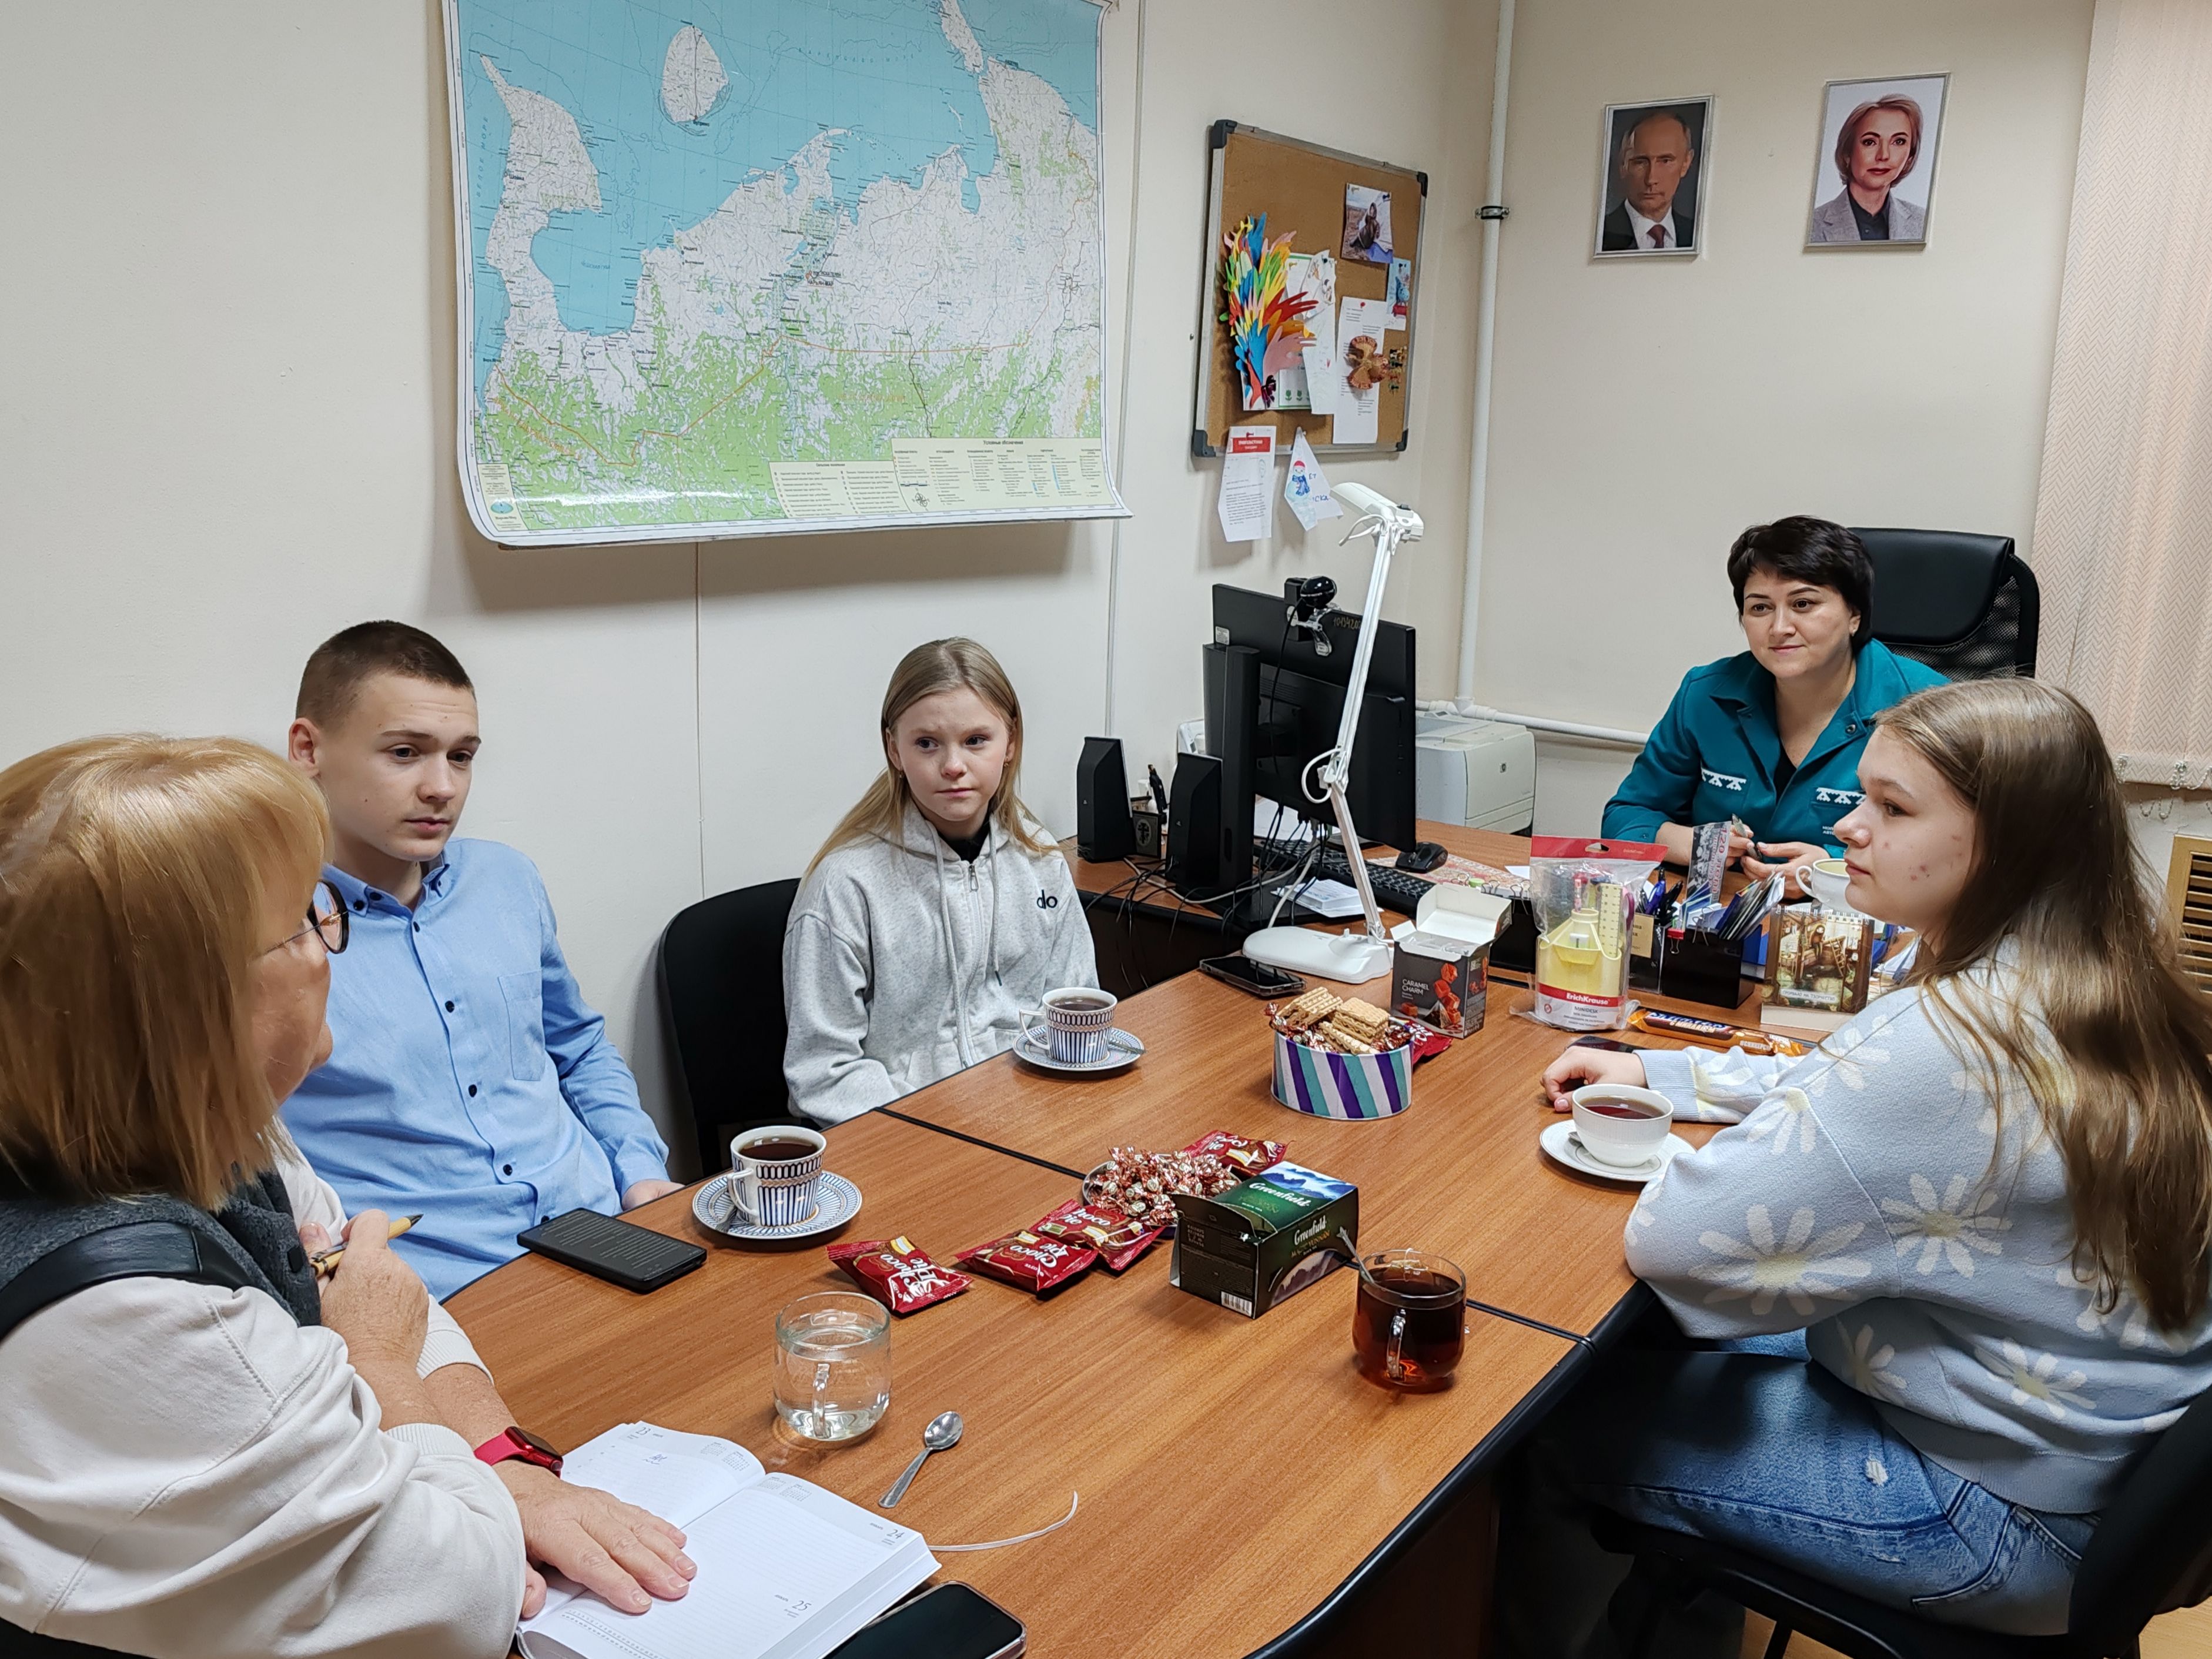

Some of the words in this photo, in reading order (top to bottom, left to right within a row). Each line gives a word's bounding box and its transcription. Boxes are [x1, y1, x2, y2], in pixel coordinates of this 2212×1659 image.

[1401, 985, 1423, 996] CHARM
[1402, 978, 1430, 991] CARAMEL
[1566, 992, 1609, 1005] ErichKrause
[1249, 1182, 1312, 1207] Greenfield
[1294, 1215, 1327, 1246] Greenfield
[1009, 1245, 1057, 1268] Choco
[886, 1528, 905, 1539] 24
[791, 1600, 812, 1611] 25
